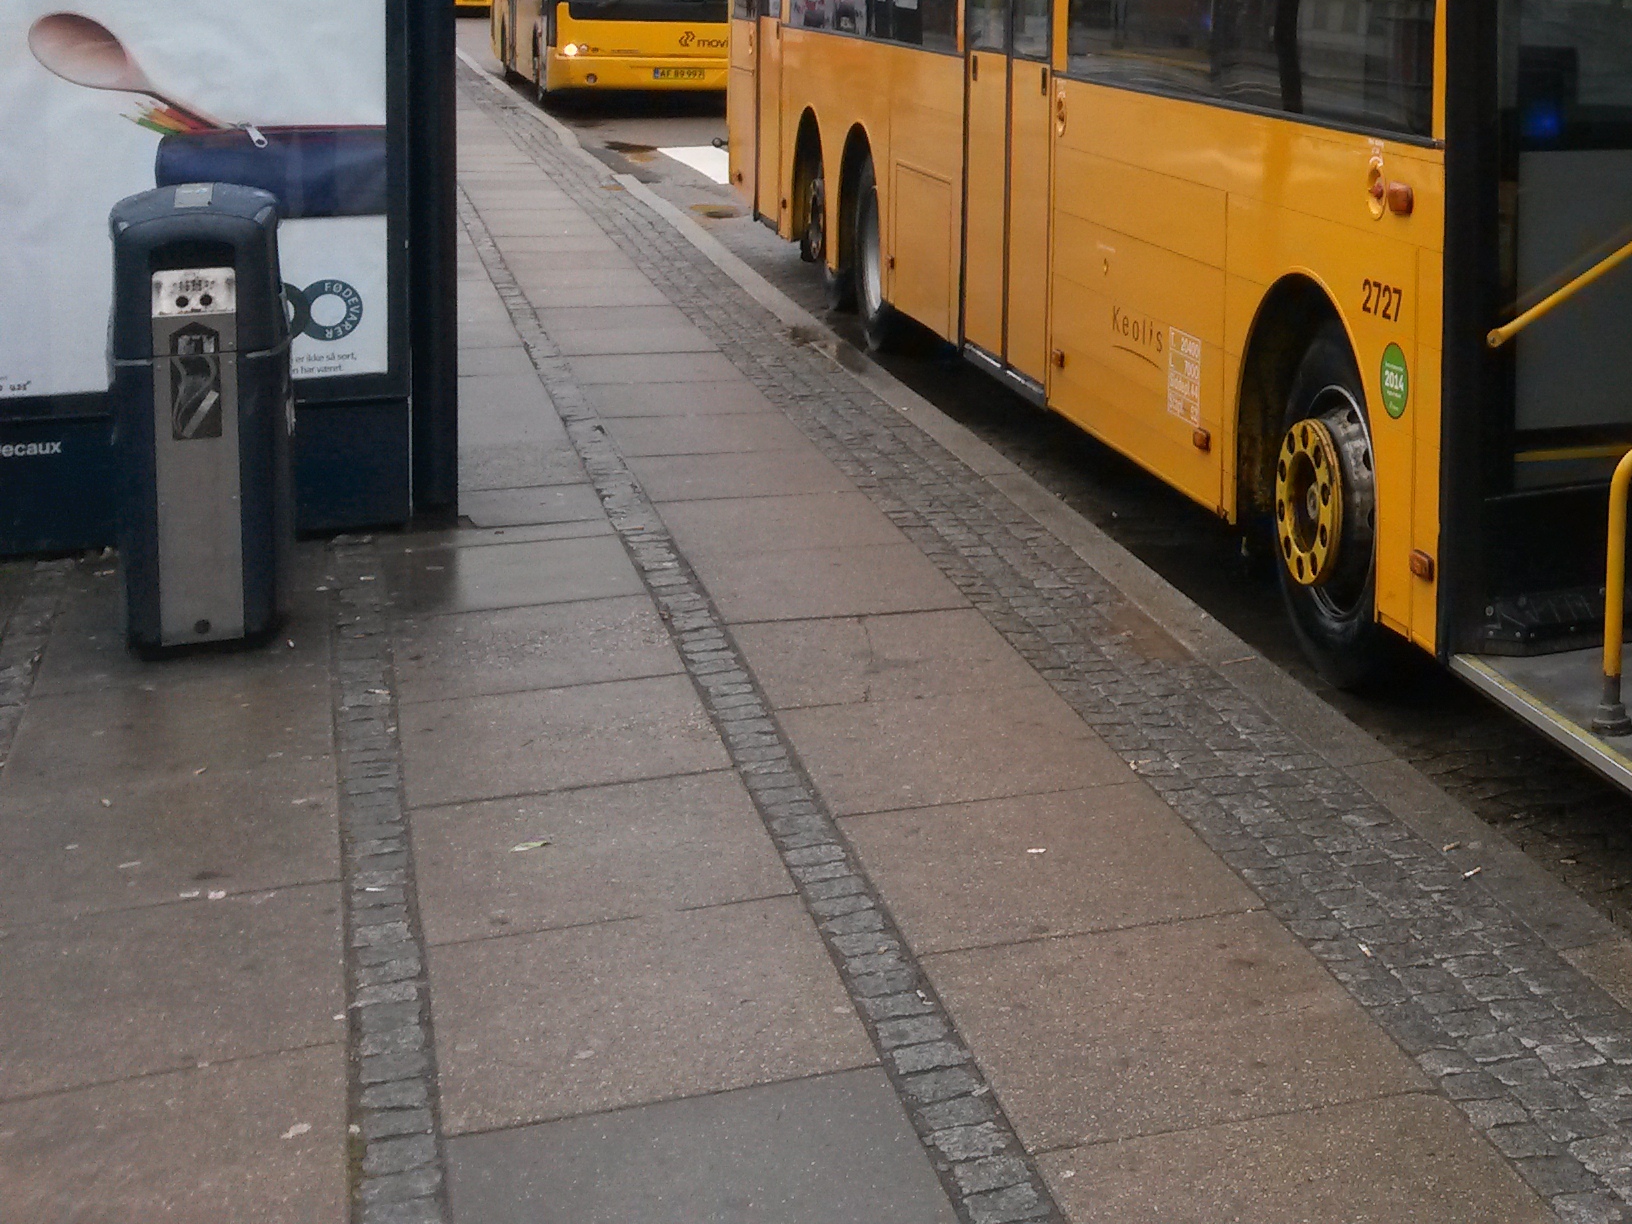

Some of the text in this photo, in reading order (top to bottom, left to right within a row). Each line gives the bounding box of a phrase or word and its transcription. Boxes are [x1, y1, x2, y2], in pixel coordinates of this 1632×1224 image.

[697, 37, 729, 49] movi
[1362, 278, 1403, 323] 2727
[1112, 305, 1164, 354] Keolis
[1385, 369, 1405, 392] 2014
[0, 441, 62, 457] ecaux
